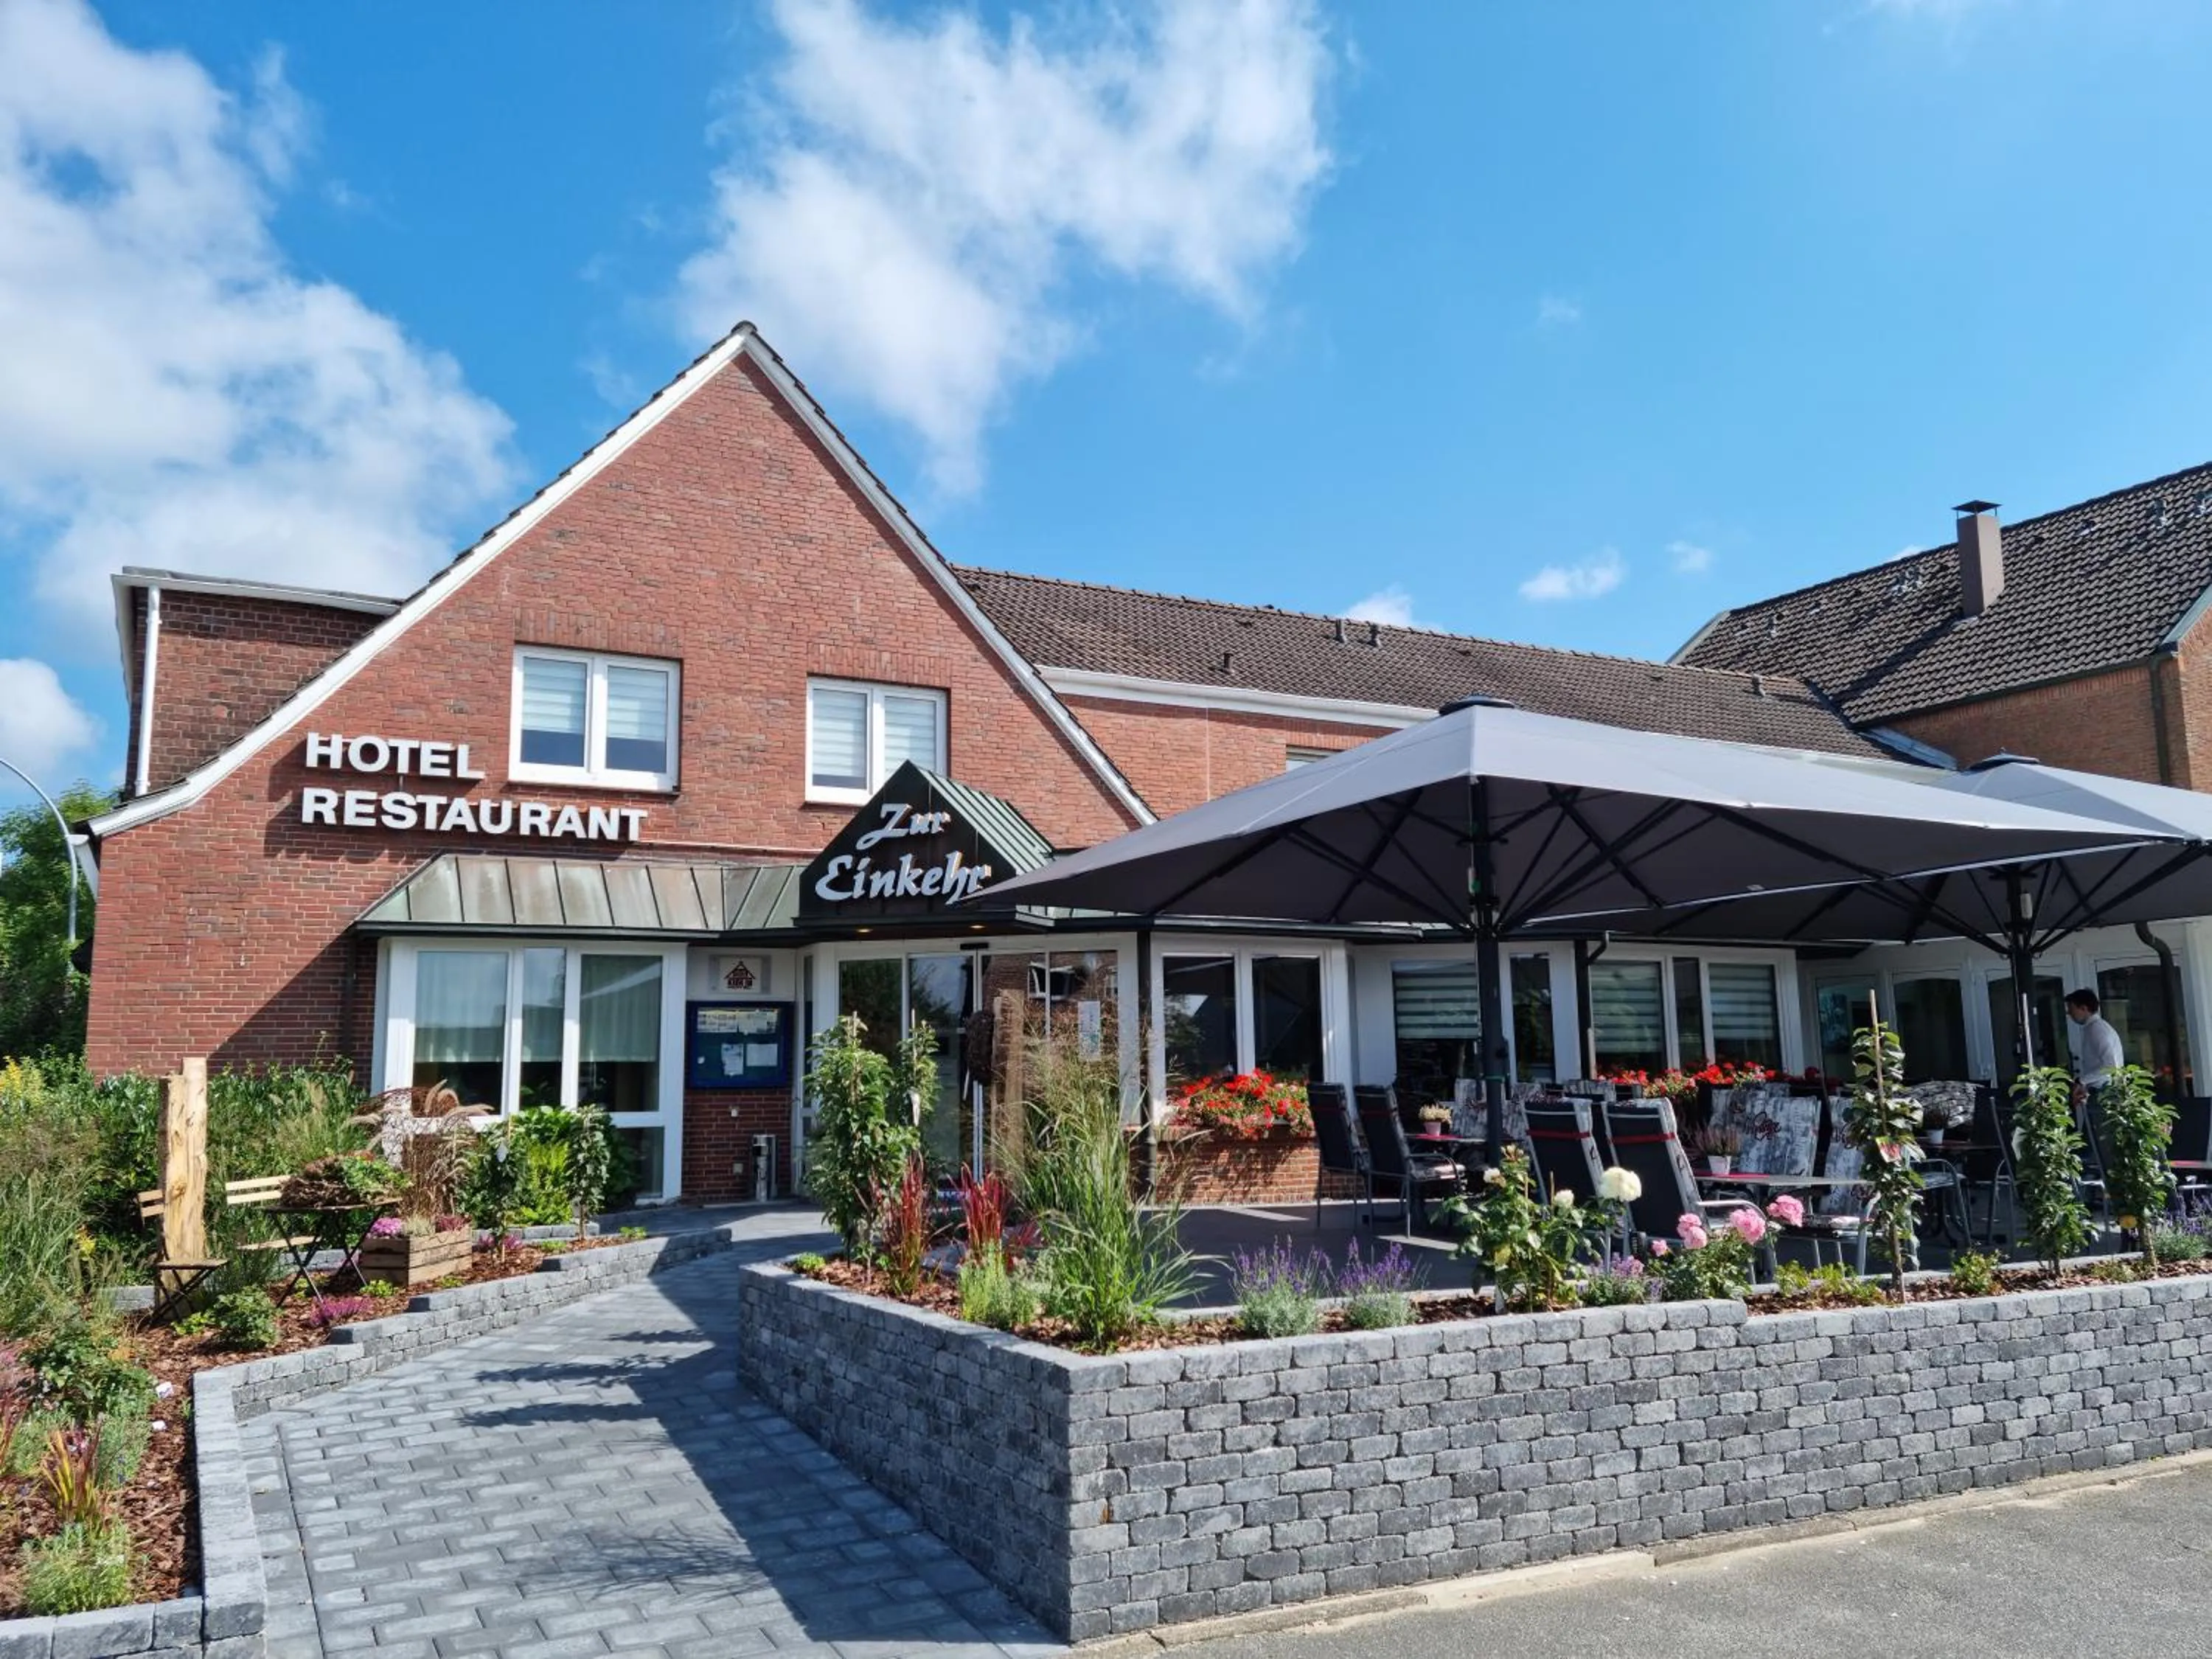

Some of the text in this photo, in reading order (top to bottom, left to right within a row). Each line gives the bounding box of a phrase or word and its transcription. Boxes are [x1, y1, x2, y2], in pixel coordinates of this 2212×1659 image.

[305, 731, 485, 780] HOTEL
[301, 786, 648, 842] RESTAURANT
[855, 802, 951, 850] Zur
[815, 850, 992, 905] Einkehr
